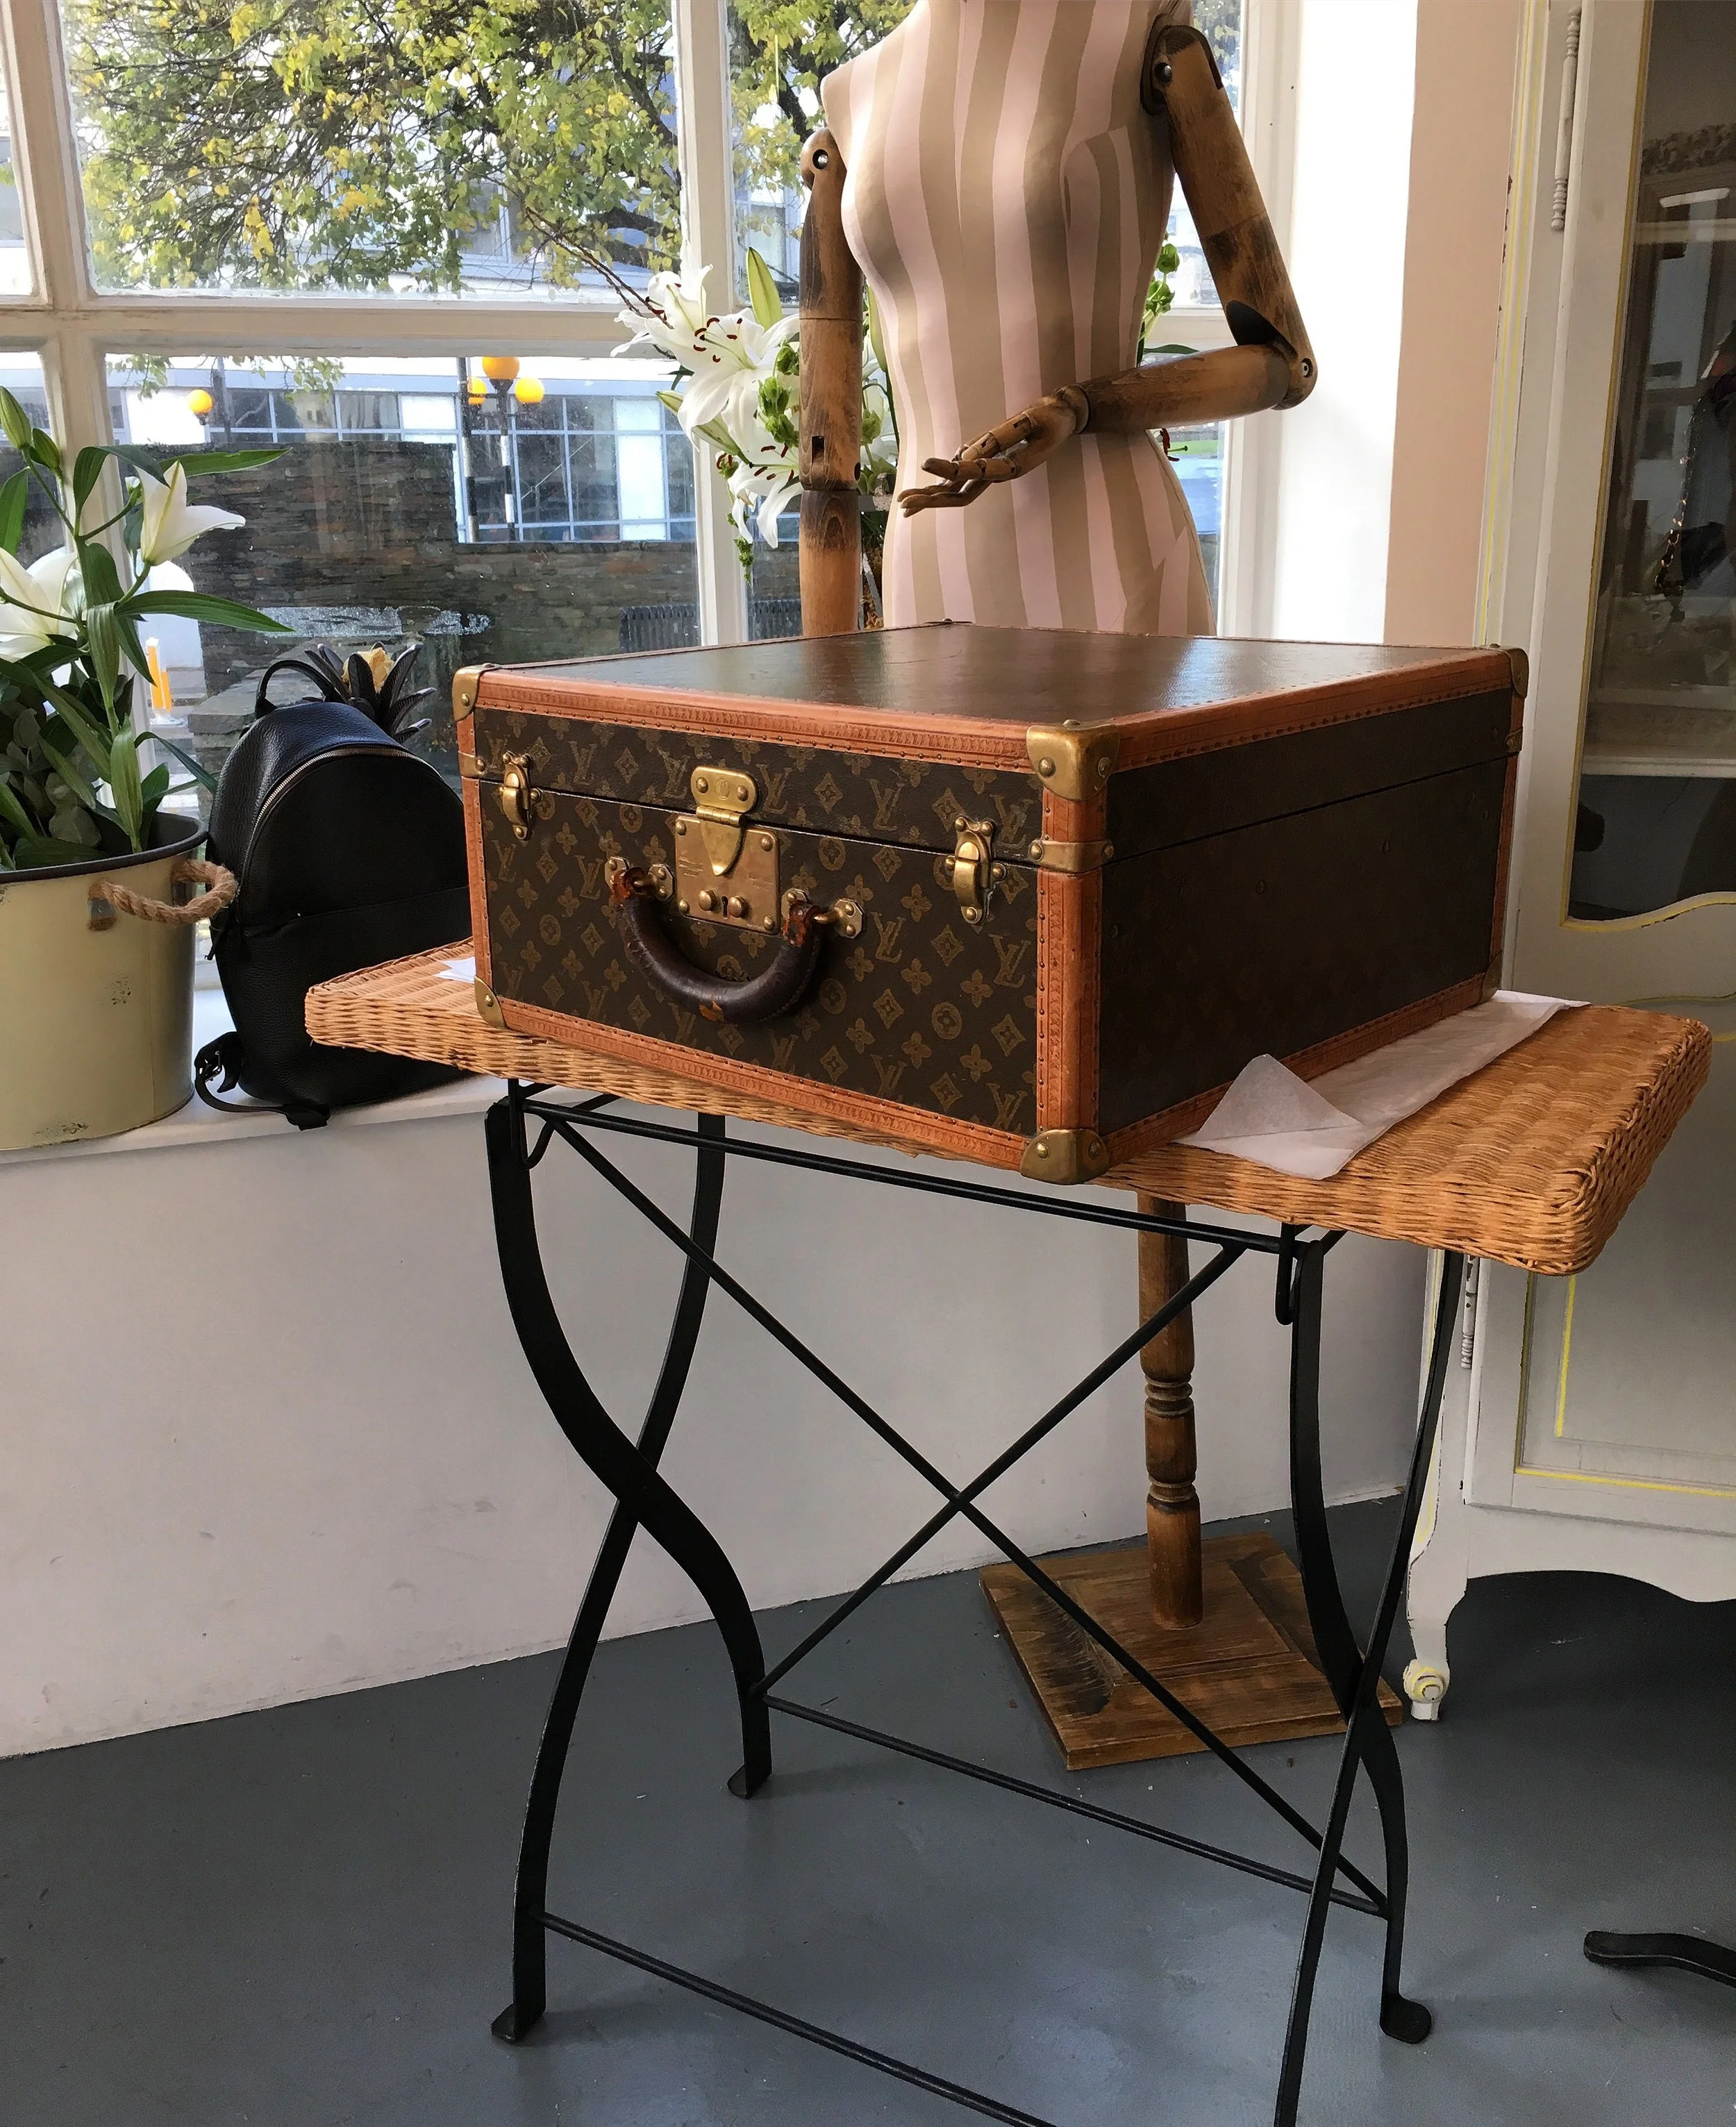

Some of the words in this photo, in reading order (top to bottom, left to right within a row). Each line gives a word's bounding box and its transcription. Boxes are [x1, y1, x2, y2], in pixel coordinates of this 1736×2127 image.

[656, 749, 689, 799] LV
[756, 764, 793, 814] LV
[868, 778, 905, 831] LV
[492, 840, 517, 883] LV
[574, 855, 603, 900] LV
[870, 911, 905, 963] LV
[988, 933, 1032, 988] LV
